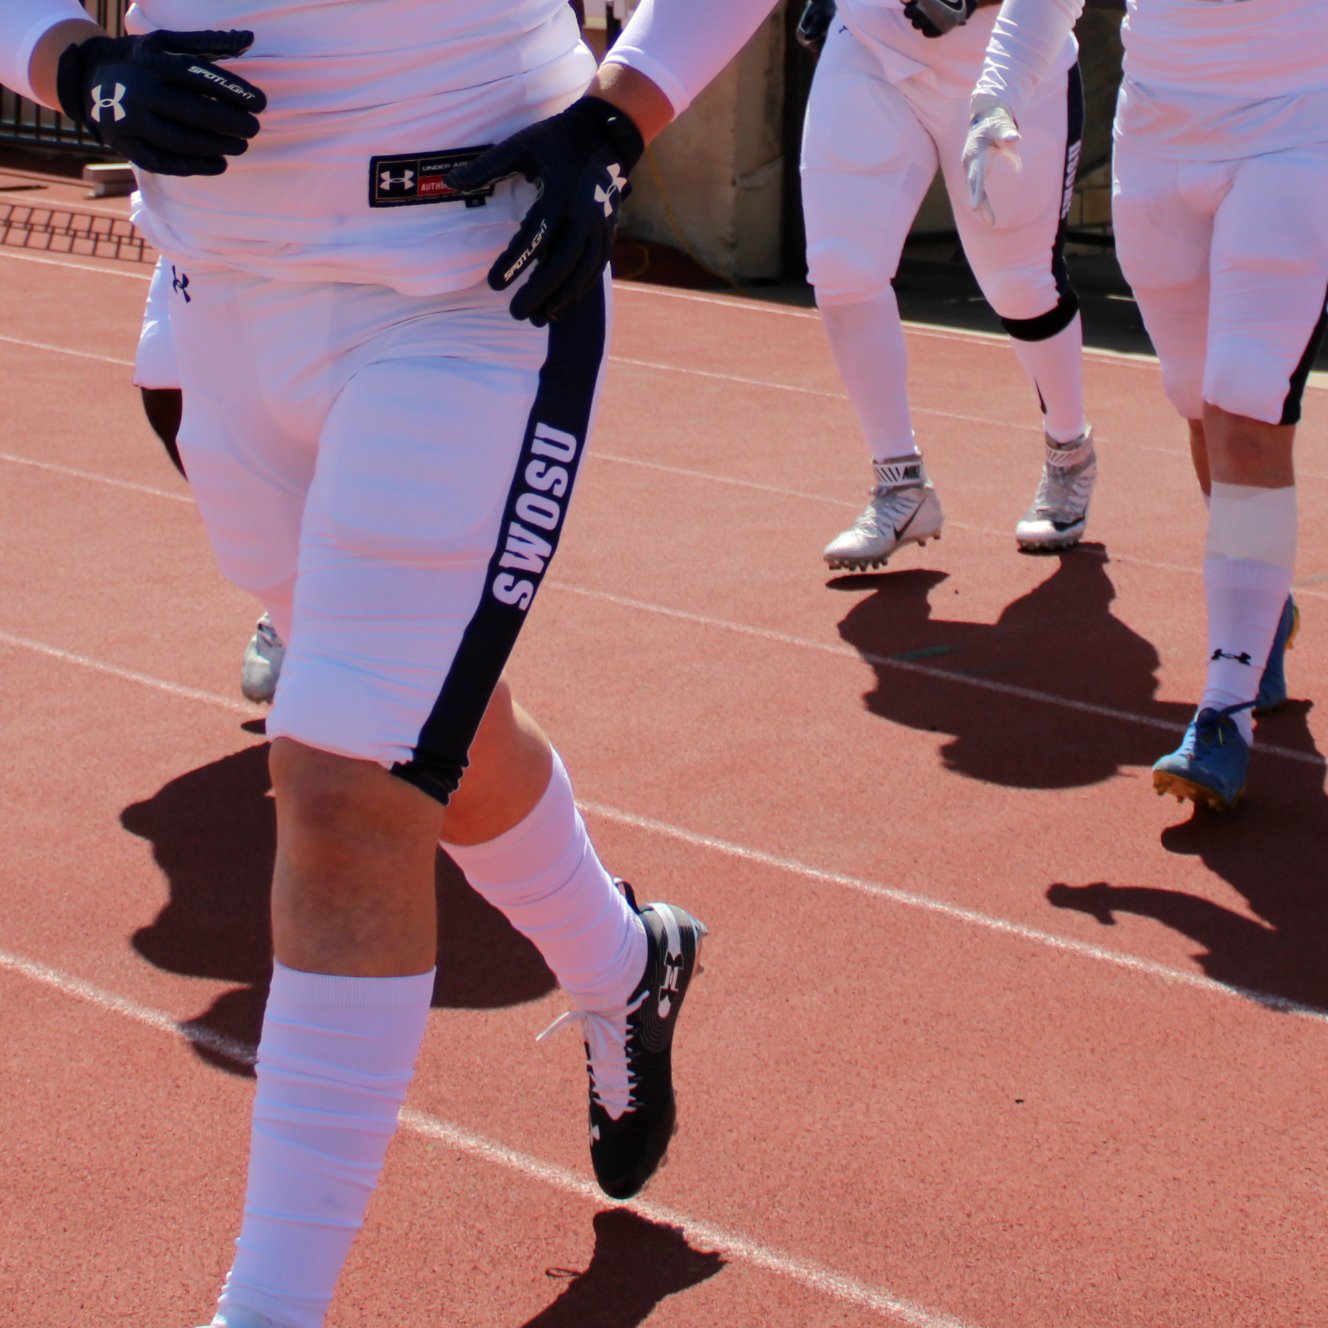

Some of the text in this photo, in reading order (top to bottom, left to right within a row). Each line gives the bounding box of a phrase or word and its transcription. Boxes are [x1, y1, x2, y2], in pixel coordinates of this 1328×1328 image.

[188, 65, 256, 100] SPOTLIGHT
[422, 163, 451, 172] UNDER
[504, 218, 547, 282] SPOTLIGHT
[492, 421, 577, 612] SWOSU
